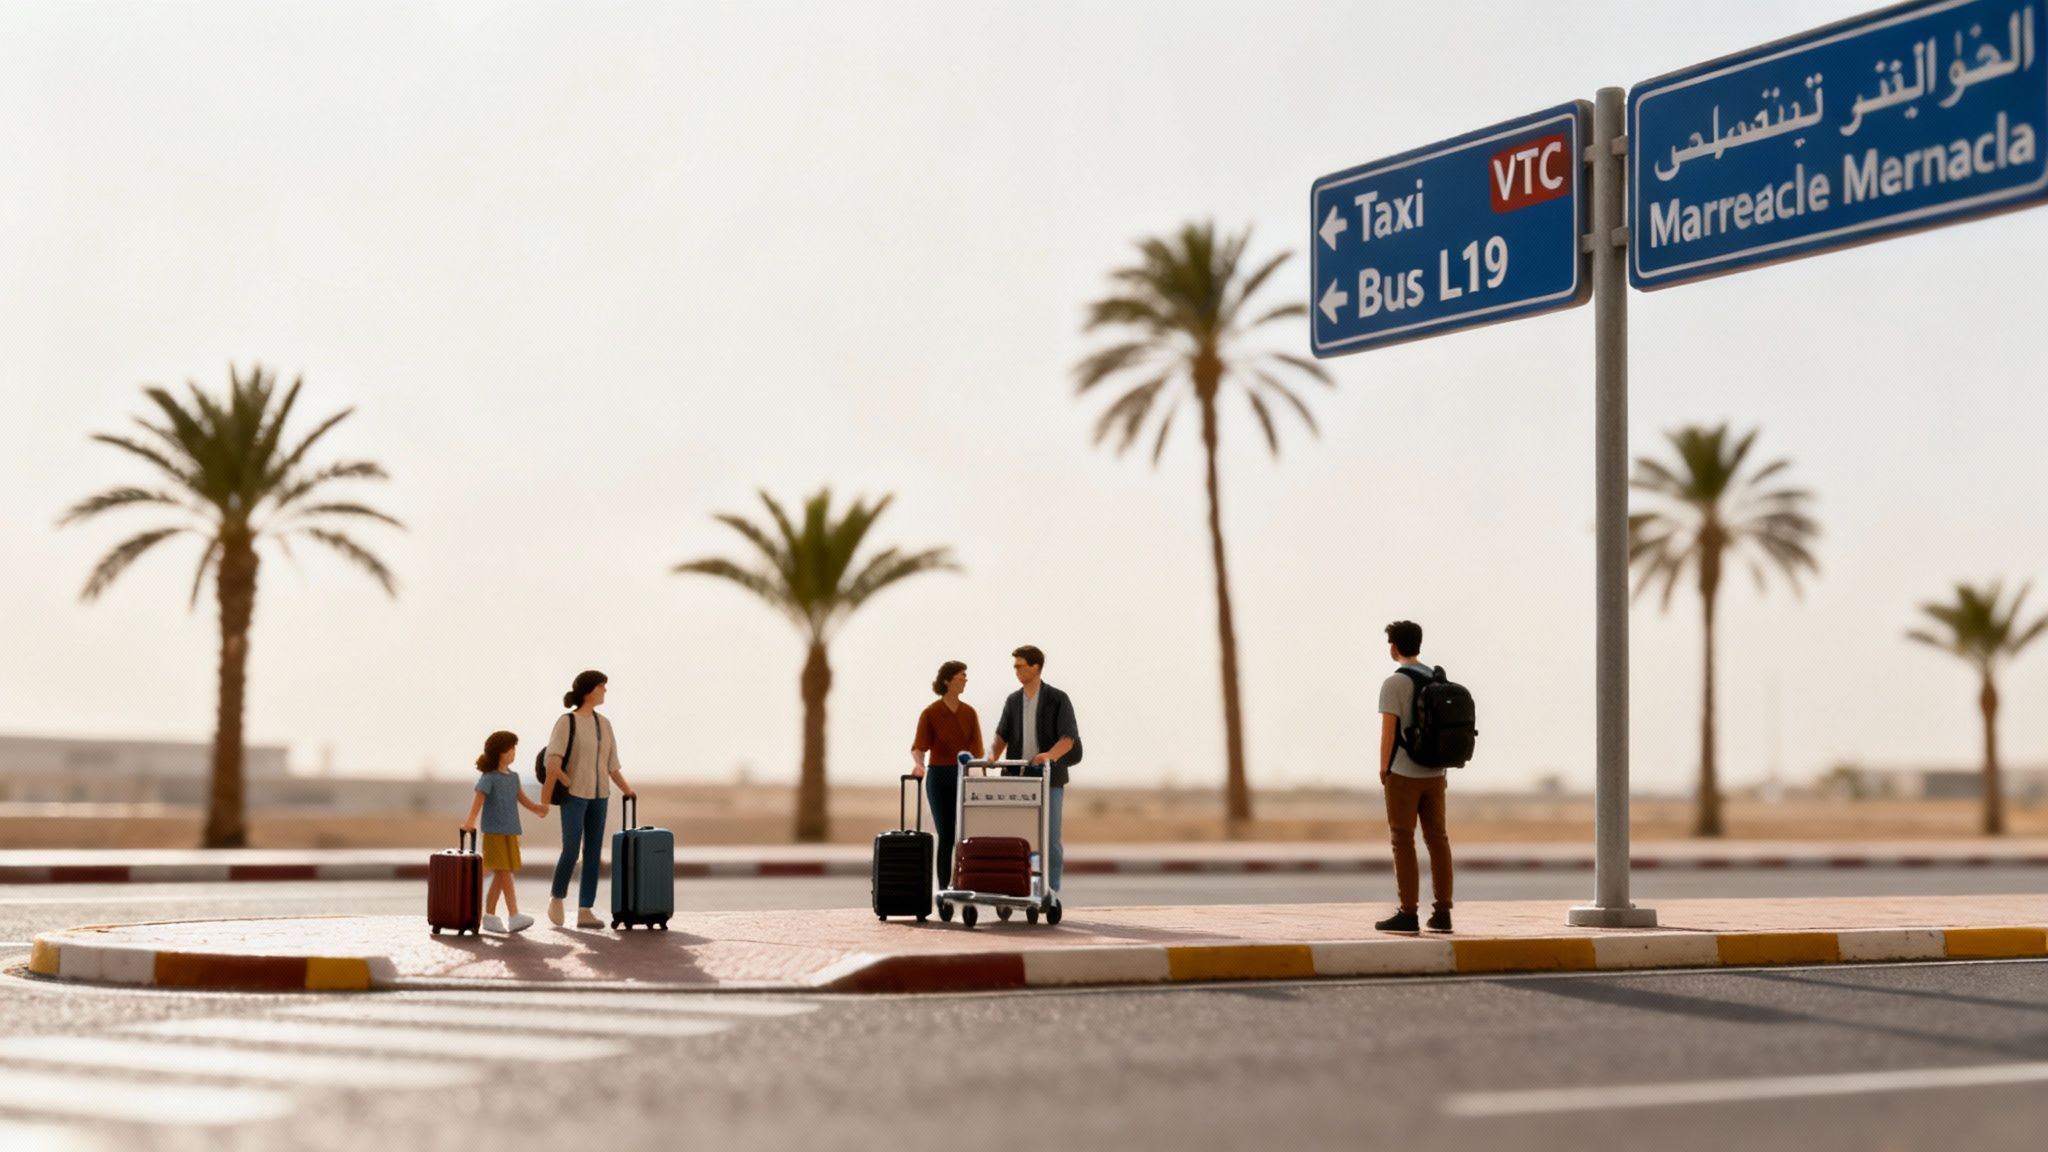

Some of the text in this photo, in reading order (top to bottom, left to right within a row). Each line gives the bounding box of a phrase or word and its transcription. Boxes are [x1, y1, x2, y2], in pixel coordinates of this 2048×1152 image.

[1493, 141, 1563, 201] VTC
[1650, 111, 2035, 248] Marreacle Mernacla
[1354, 178, 1424, 243] Taxi
[1357, 235, 1509, 319] Bus L19
